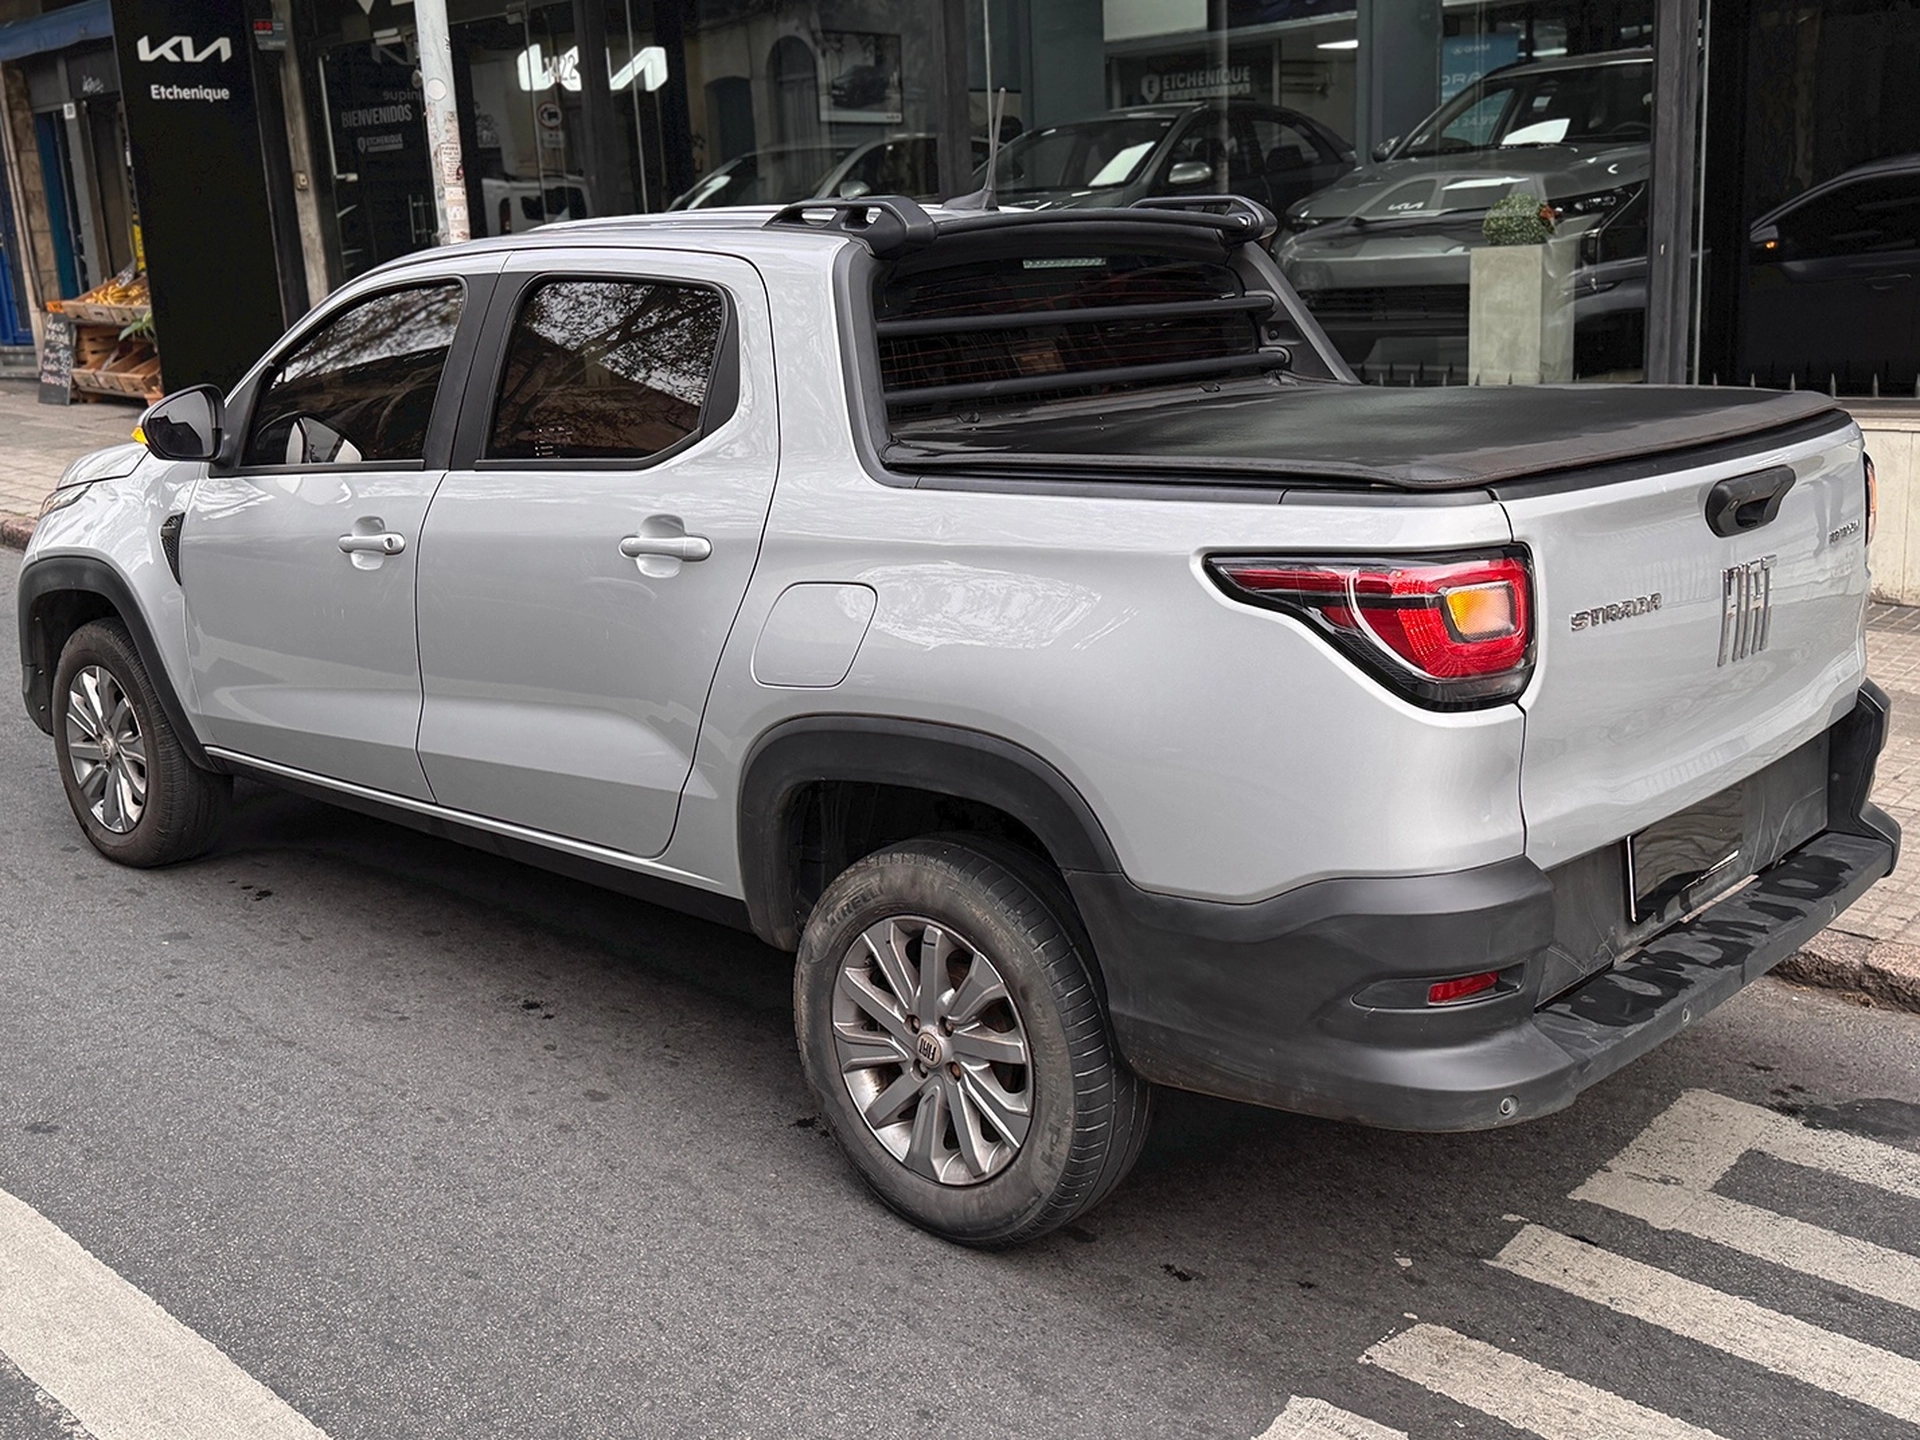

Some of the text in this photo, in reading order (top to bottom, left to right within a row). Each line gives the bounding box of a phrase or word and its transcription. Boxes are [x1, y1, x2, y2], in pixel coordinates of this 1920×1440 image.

[137, 35, 232, 62] KIA
[1162, 66, 1250, 90] ETCHENIQUE
[150, 84, 230, 103] Etchenique
[341, 103, 413, 128] BIENVENIDOS
[1570, 592, 1663, 632] STRADA
[1716, 554, 1777, 667] FIAT
[918, 1037, 937, 1062] FIAT
